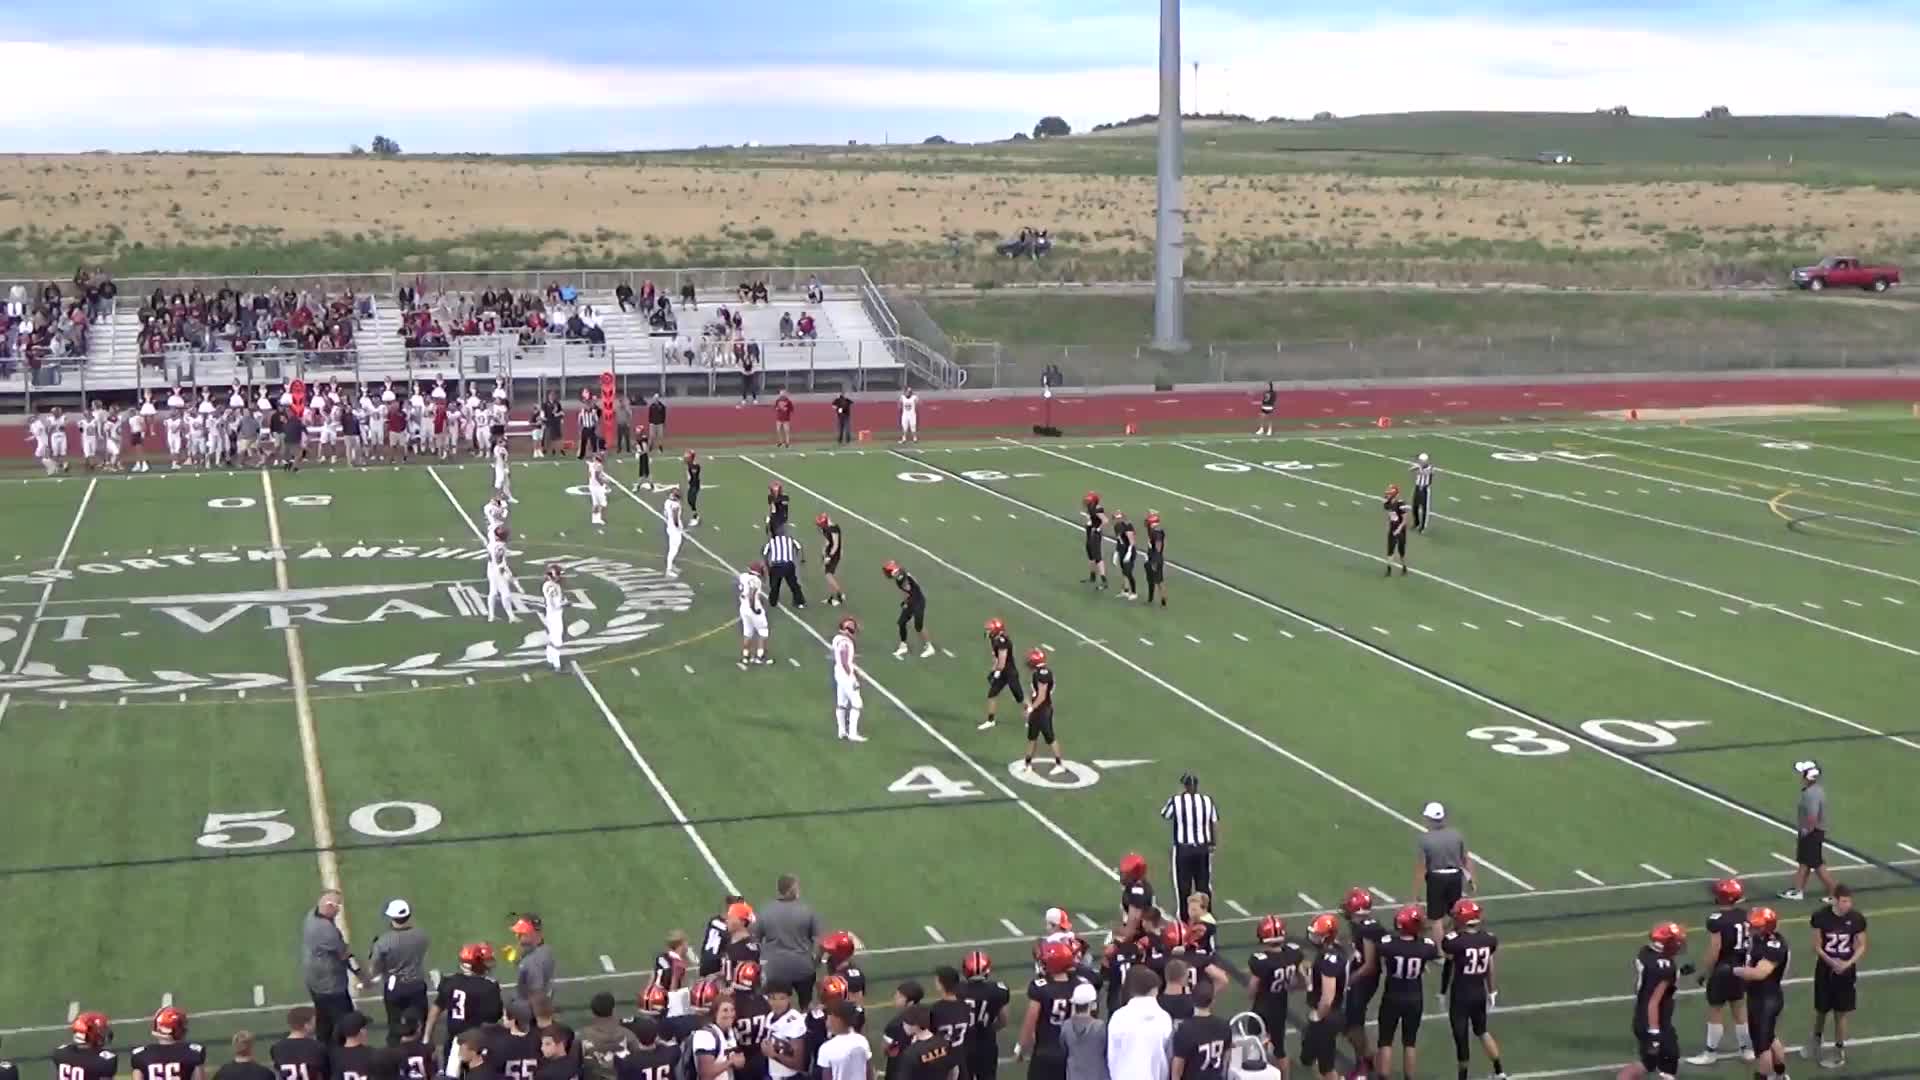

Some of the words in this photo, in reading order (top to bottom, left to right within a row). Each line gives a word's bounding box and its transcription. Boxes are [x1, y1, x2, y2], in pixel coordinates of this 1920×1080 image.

[1466, 719, 1677, 756] 30
[888, 757, 1100, 798] 40
[197, 801, 442, 848] 50
[1825, 933, 1850, 953] 22
[1463, 947, 1490, 975] 33
[452, 989, 467, 1020] 3
[736, 1015, 765, 1046] 27
[505, 1059, 538, 1080] 55
